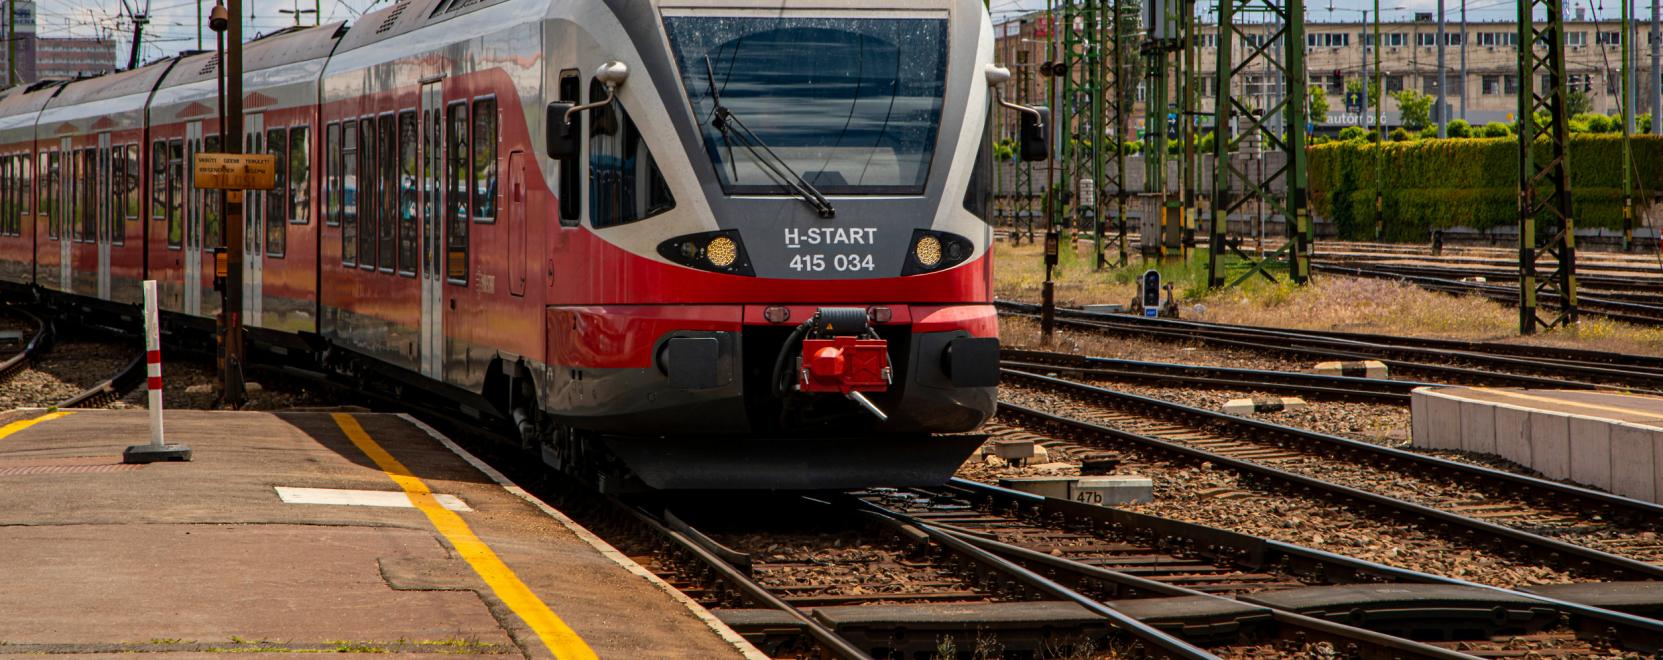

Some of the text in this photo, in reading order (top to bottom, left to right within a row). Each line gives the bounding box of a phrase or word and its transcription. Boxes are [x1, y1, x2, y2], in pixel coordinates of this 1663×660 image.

[784, 227, 878, 248] H-START
[789, 254, 875, 272] 415 034
[1077, 491, 1102, 504] 47b
